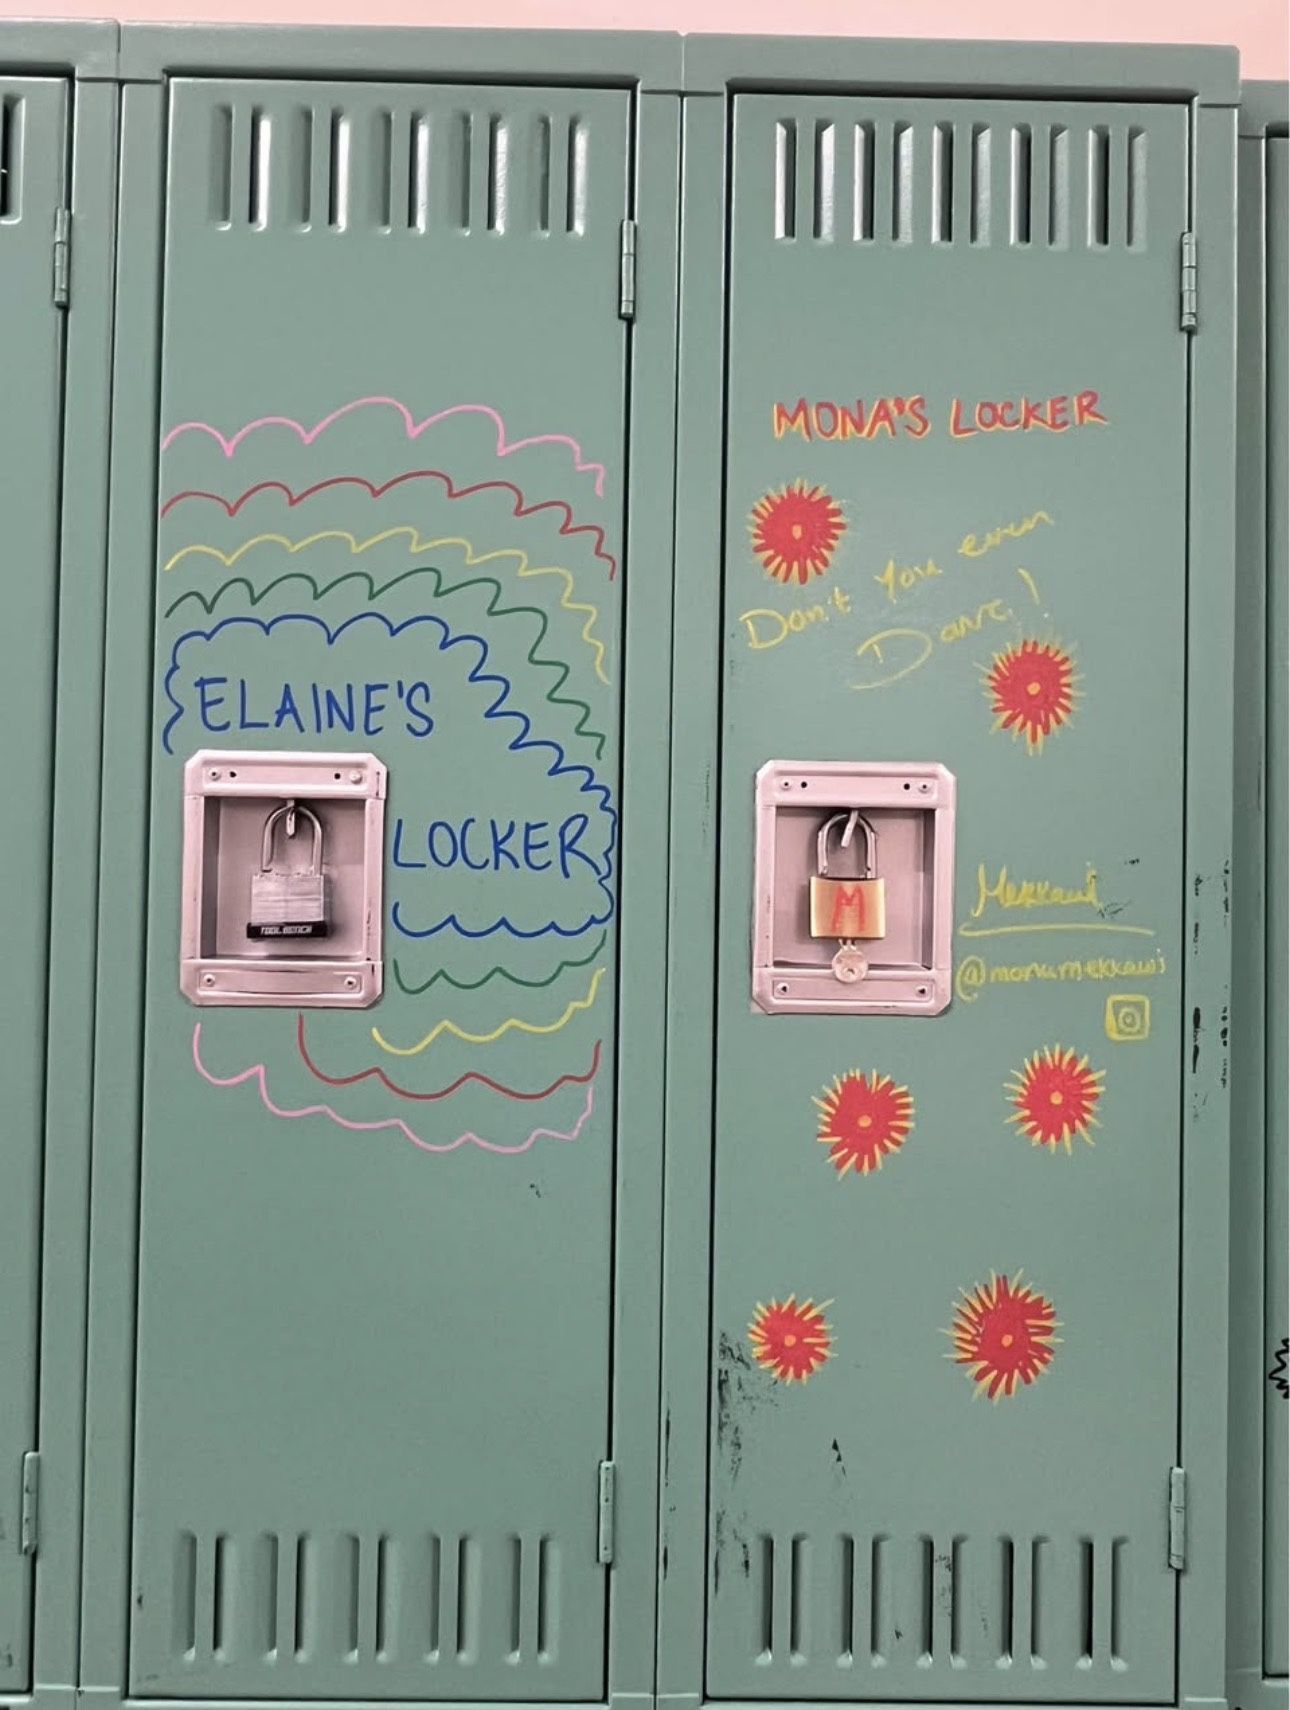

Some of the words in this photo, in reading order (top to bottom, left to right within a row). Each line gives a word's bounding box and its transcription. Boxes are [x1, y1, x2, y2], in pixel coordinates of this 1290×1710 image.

[773, 395, 932, 442] MONA'S
[949, 389, 1108, 438] LOCKER
[739, 586, 852, 649] Don't
[873, 558, 943, 604] You
[957, 510, 1055, 557] even
[194, 677, 434, 737] ELAINE'S
[393, 814, 602, 879] LOCKER
[831, 884, 867, 933] M
